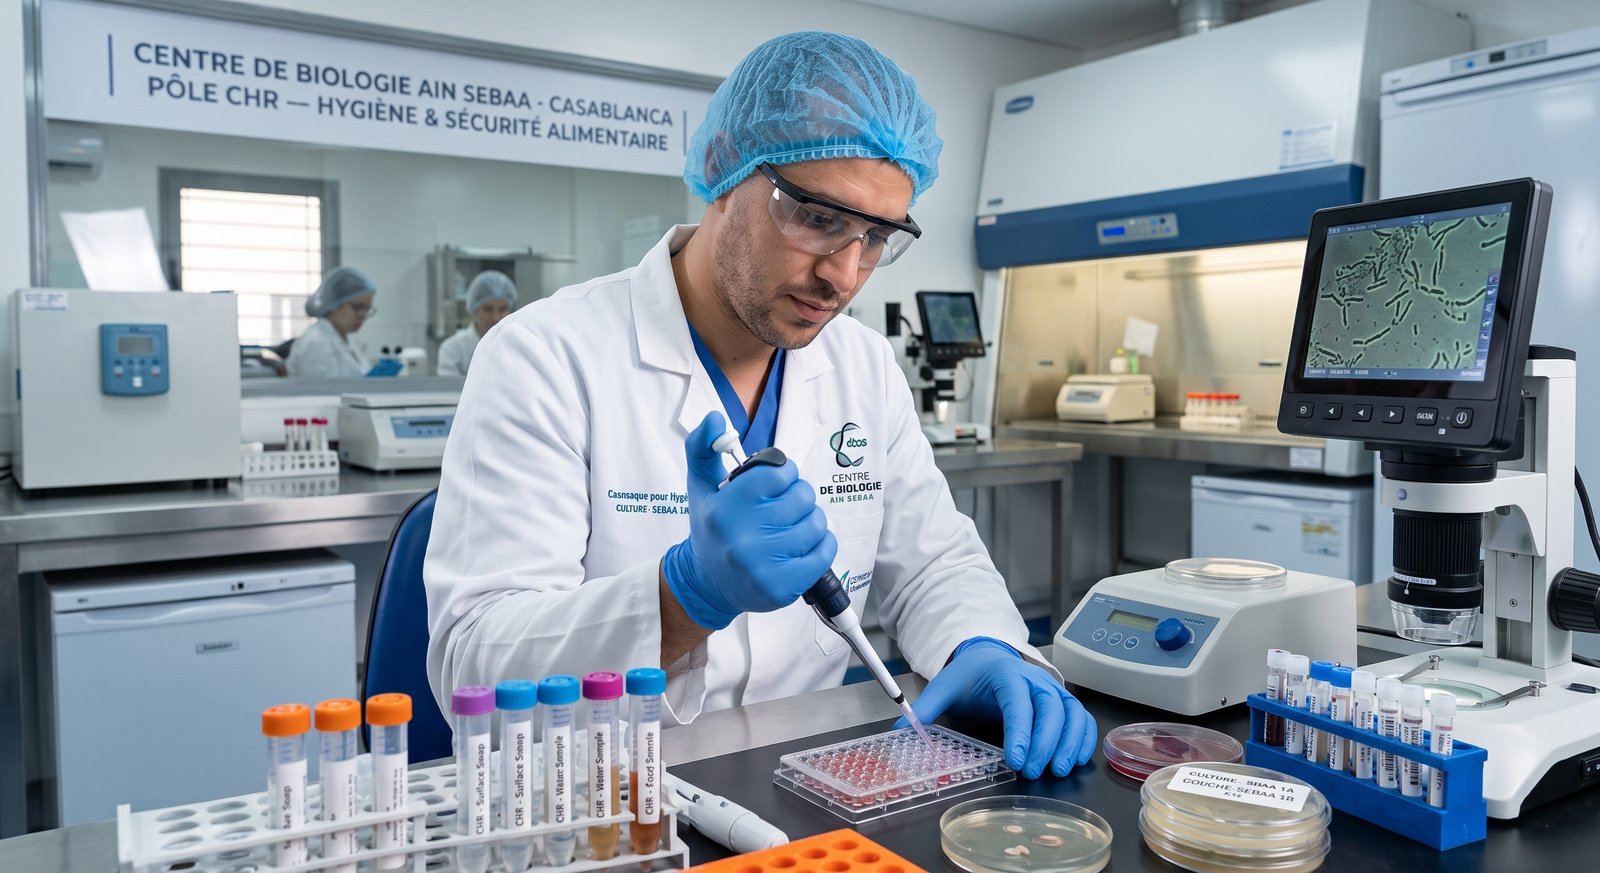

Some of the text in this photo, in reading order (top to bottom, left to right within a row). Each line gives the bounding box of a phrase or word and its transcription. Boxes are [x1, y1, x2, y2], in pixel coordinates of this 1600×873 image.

[134, 42, 245, 75] CENTRE
[254, 58, 288, 80] DE
[297, 63, 411, 96] BIOLOGIE
[418, 79, 456, 100] AIN
[463, 84, 532, 110] SEBAA
[549, 96, 674, 127] CASABLANCA
[148, 73, 218, 103] PÔLE
[226, 85, 279, 110] CHR
[318, 96, 418, 124] HYGIÈNE
[424, 108, 439, 127] &
[445, 108, 542, 138] SÉCURITÉ
[547, 123, 669, 151] ALIMENTAIRE
[832, 472, 870, 483] CENTRE
[820, 481, 882, 495] DE BIOLOGIE
[650, 493, 668, 502] pour
[847, 494, 874, 502] SEBAA
[652, 505, 677, 514] SEBAA
[1281, 786, 1294, 794] 1A
[556, 804, 564, 823] CHR
[596, 800, 605, 818] CHR
[645, 797, 654, 815] CHR
[476, 815, 485, 835] CHR
[515, 807, 524, 827] CHR
